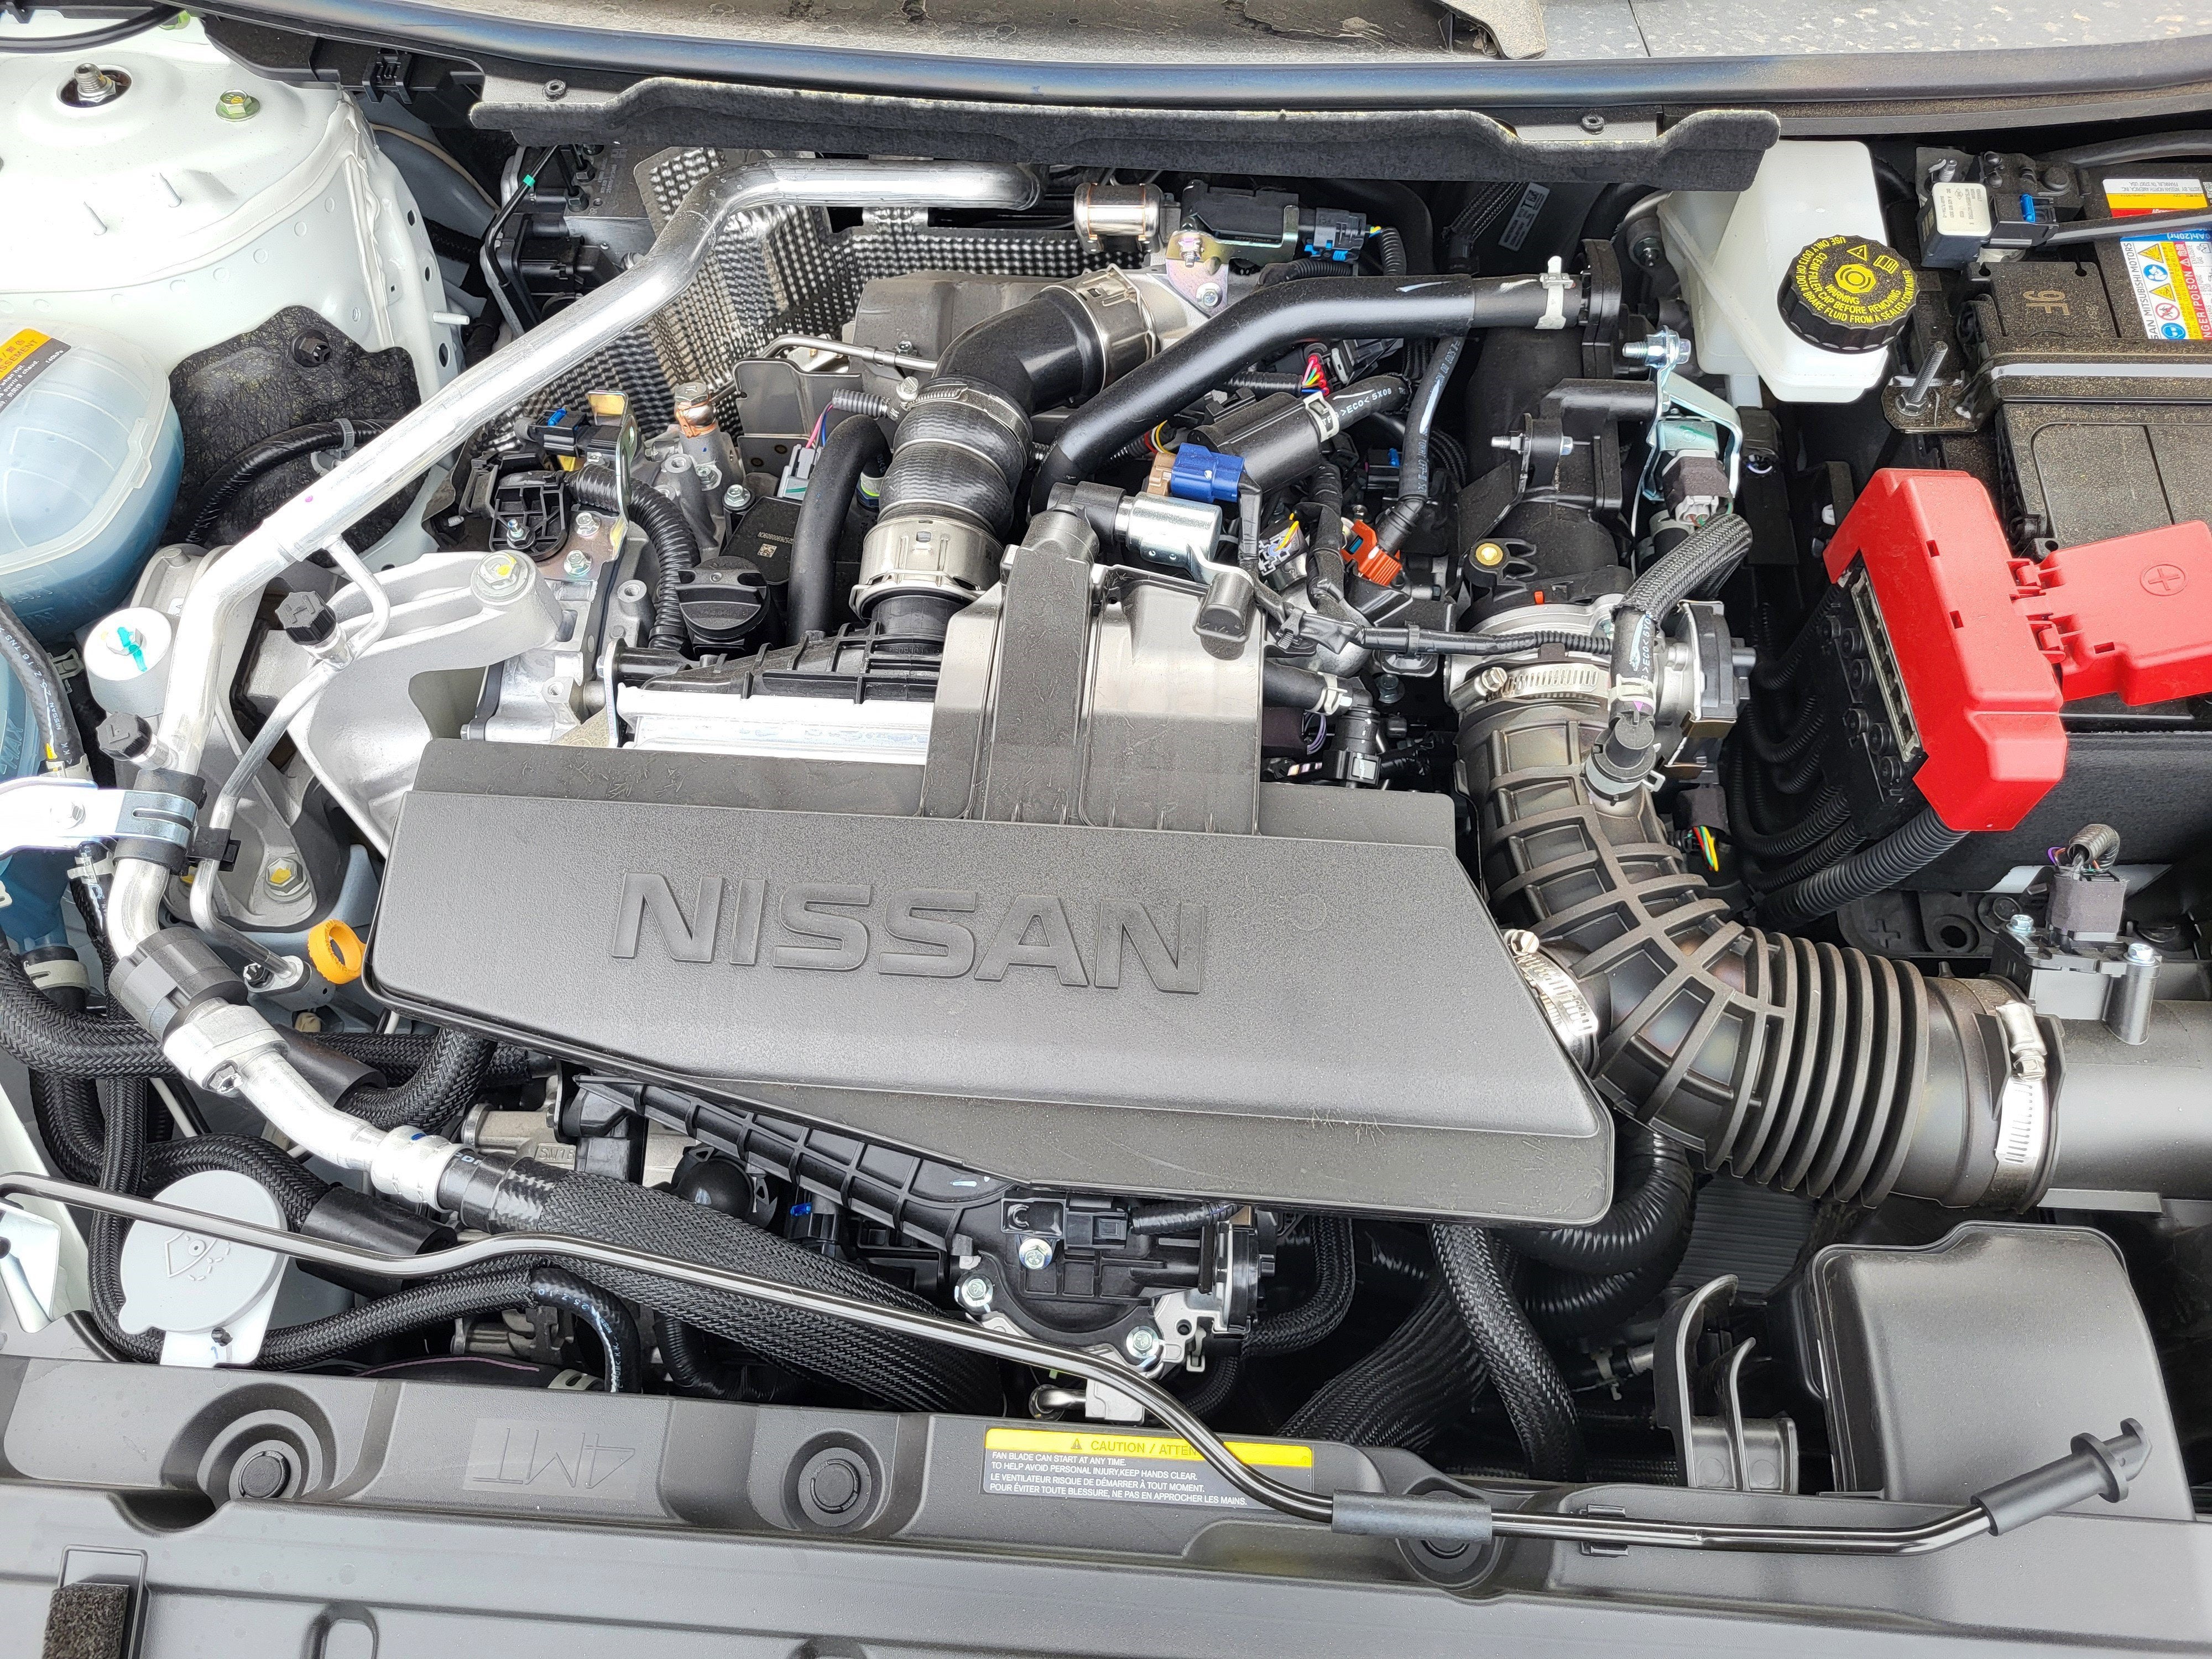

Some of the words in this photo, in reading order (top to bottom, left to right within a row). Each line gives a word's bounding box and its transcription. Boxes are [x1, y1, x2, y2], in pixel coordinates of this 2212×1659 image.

[1811, 239, 1830, 253] ONLY
[1830, 237, 1846, 246] USE
[1798, 249, 1815, 265] DOT3
[1808, 252, 1828, 271] CLEAN
[2123, 242, 2140, 273] MOTORS
[1796, 265, 1806, 274] OR
[1808, 271, 1823, 293] FILLER
[1901, 270, 1916, 303] CONTAINER
[1802, 290, 1826, 311] BRAKE
[1818, 291, 1835, 305] CAP
[1824, 284, 1860, 305] WARNING
[1867, 289, 1902, 314] REMOVING
[2022, 290, 2071, 316] 9F
[2133, 274, 2152, 318] MITSUBISHI
[1823, 307, 1848, 321] FLUID
[1833, 301, 1867, 314] BEFORE
[1880, 302, 1907, 320] SEALED
[1849, 315, 1874, 324] FROM
[1875, 314, 1881, 322] A
[45, 349, 64, 364] 140kPa
[0, 373, 15, 387] when
[15, 364, 25, 374] hot.
[3, 377, 19, 393] ouvrir
[1371, 387, 1392, 400] 5X08
[284, 594, 316, 624] H
[5, 634, 21, 651] TNS
[49, 702, 62, 731] NISSAN
[107, 724, 131, 744] L
[611, 871, 1205, 995] NISSAN
[1091, 1440, 1145, 1453] CAUTION
[1159, 1444, 1197, 1456] ATTEN
[992, 1452, 1007, 1460] FAN
[1009, 1452, 1035, 1462] BLADE
[1035, 1453, 1052, 1462] CAN
[1053, 1454, 1078, 1464] START
[1078, 1455, 1089, 1464] AT
[1089, 1456, 1106, 1465] ANY
[1107, 1457, 1127, 1466] TIME.
[992, 1461, 1003, 1470] TO
[1004, 1462, 1024, 1470] HELP
[1024, 1463, 1048, 1472] AVOID
[1050, 1464, 1092, 1475] PERSONAL
[1141, 1469, 1170, 1479] HANDS
[1170, 1471, 1198, 1480] CLEAR.
[1001, 1473, 1051, 1484] VENTILATEUR
[1052, 1475, 1082, 1486] RISQUE
[1083, 1478, 1094, 1486] DE
[1095, 1477, 1138, 1489] DÉMARRER
[1139, 1478, 1146, 1489] À
[1146, 1480, 1168, 1491] TOUT
[1168, 1482, 1205, 1493] MOMENT.
[990, 1483, 1013, 1492] POUR
[1014, 1482, 1040, 1494] ÉVITER
[1041, 1485, 1067, 1495] TOUTE
[1068, 1486, 1110, 1499] BLESSURE,
[1112, 1490, 1123, 1498] NE
[1124, 1490, 1140, 1499] PAS
[1141, 1491, 1152, 1499] EN
[1153, 1491, 1203, 1504] APPROCHER
[1204, 1495, 1219, 1504] LES
[1220, 1496, 1248, 1506] MAINS.
